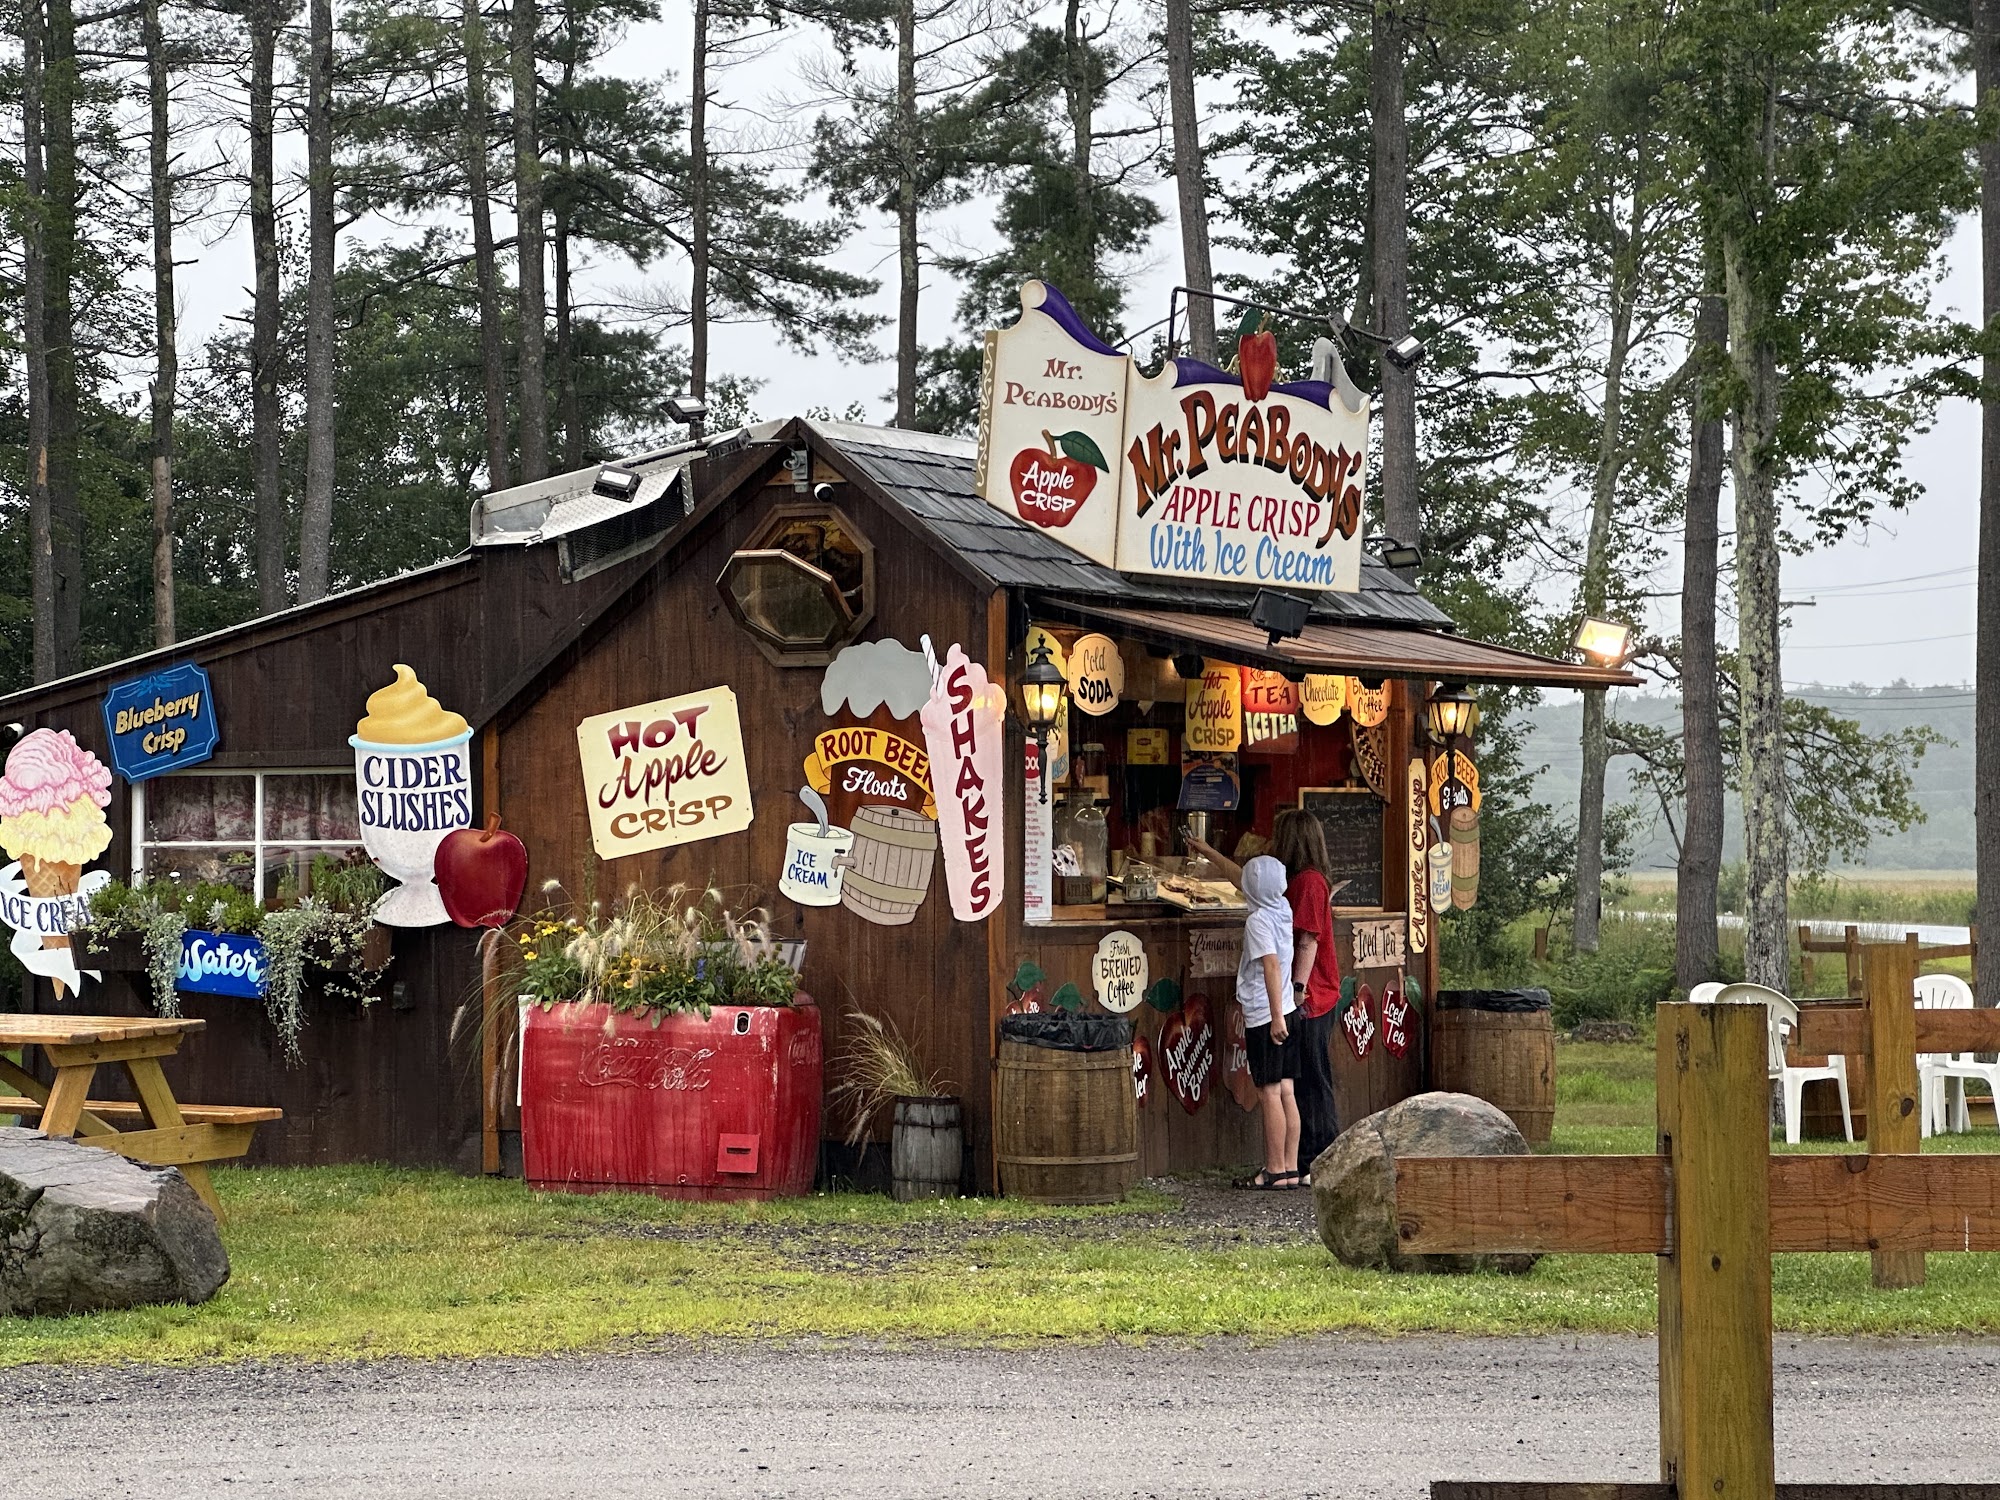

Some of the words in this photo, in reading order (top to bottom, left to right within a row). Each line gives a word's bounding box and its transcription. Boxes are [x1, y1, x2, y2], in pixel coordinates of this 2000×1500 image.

[1042, 357, 1083, 380] Mr.
[1021, 461, 1074, 490] Apple
[1127, 422, 1184, 518] Mr.
[1020, 489, 1077, 513] CRISP
[1160, 486, 1240, 529] APPLE
[1247, 495, 1320, 542] CRISP
[1150, 523, 1208, 573] With
[1213, 529, 1247, 575] Ice
[1256, 535, 1335, 586] Cream
[1083, 646, 1106, 677] Cold
[1078, 676, 1114, 704] SODA
[1201, 671, 1229, 690] Hot
[1250, 685, 1291, 705] TEA
[1304, 677, 1339, 703] Chocolate
[114, 690, 200, 736] Blueberry
[1189, 690, 1234, 727] Apple
[1357, 697, 1383, 722] Coffee
[142, 726, 186, 756] Crisp
[607, 706, 709, 760] HOT
[821, 731, 878, 762] ROOT
[1192, 727, 1235, 746] CRISP
[363, 754, 467, 789] CIDER
[598, 739, 728, 809] Apple
[842, 767, 909, 801] Floats
[1456, 753, 1476, 791] BEER
[946, 665, 991, 914] SHAKES
[361, 788, 471, 832] SLUSHES
[1411, 774, 1427, 852] Crisp
[796, 849, 817, 868] ICE
[788, 864, 829, 889] CREAM
[1432, 881, 1450, 898] CREAM
[1436, 869, 1445, 883] ICE
[0, 891, 32, 930] ICE
[37, 896, 91, 934] CREA
[1411, 857, 1427, 948] Apple
[178, 939, 264, 982] Water
[1110, 940, 1131, 958] Fresh
[1358, 926, 1378, 963] Iced
[1380, 924, 1397, 962] Tea
[1100, 956, 1142, 980] BREWED
[1107, 978, 1135, 1007] Coffee
[1383, 990, 1408, 1027] Iced
[1343, 1006, 1355, 1032] Ice
[1352, 1001, 1368, 1037] Cold
[1386, 1018, 1406, 1047] Tea
[1165, 1025, 1194, 1080] Apple
[1357, 1021, 1375, 1055] Soda
[1176, 1023, 1213, 1098] Cinnamon
[1188, 1048, 1213, 1102] Buns
